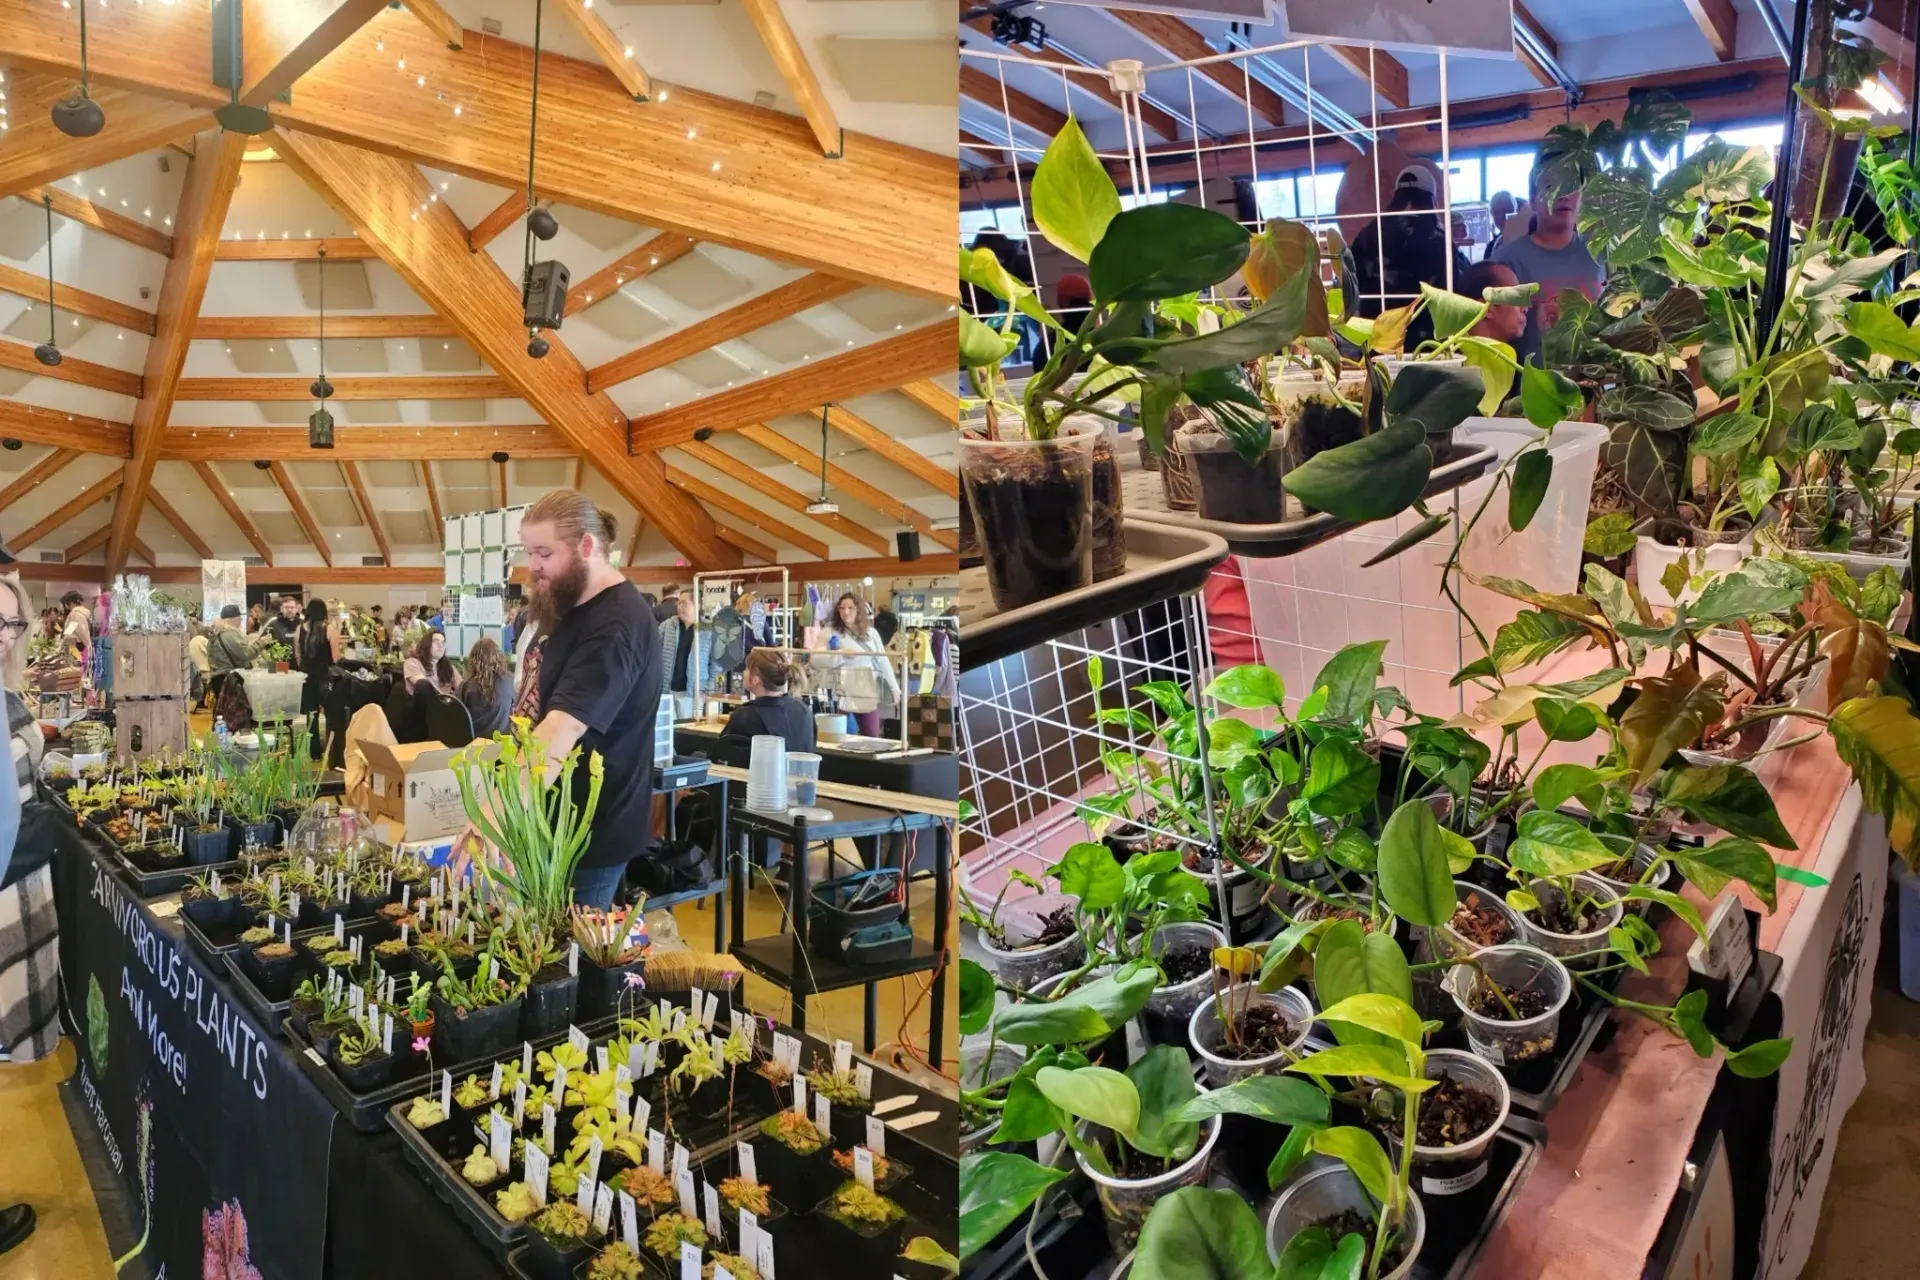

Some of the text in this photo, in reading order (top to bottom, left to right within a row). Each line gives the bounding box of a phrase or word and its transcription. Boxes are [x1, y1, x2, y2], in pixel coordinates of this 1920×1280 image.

[91, 861, 268, 1100] ARNIVOROUS PLANTS
[579, 1176, 592, 1192] $20
